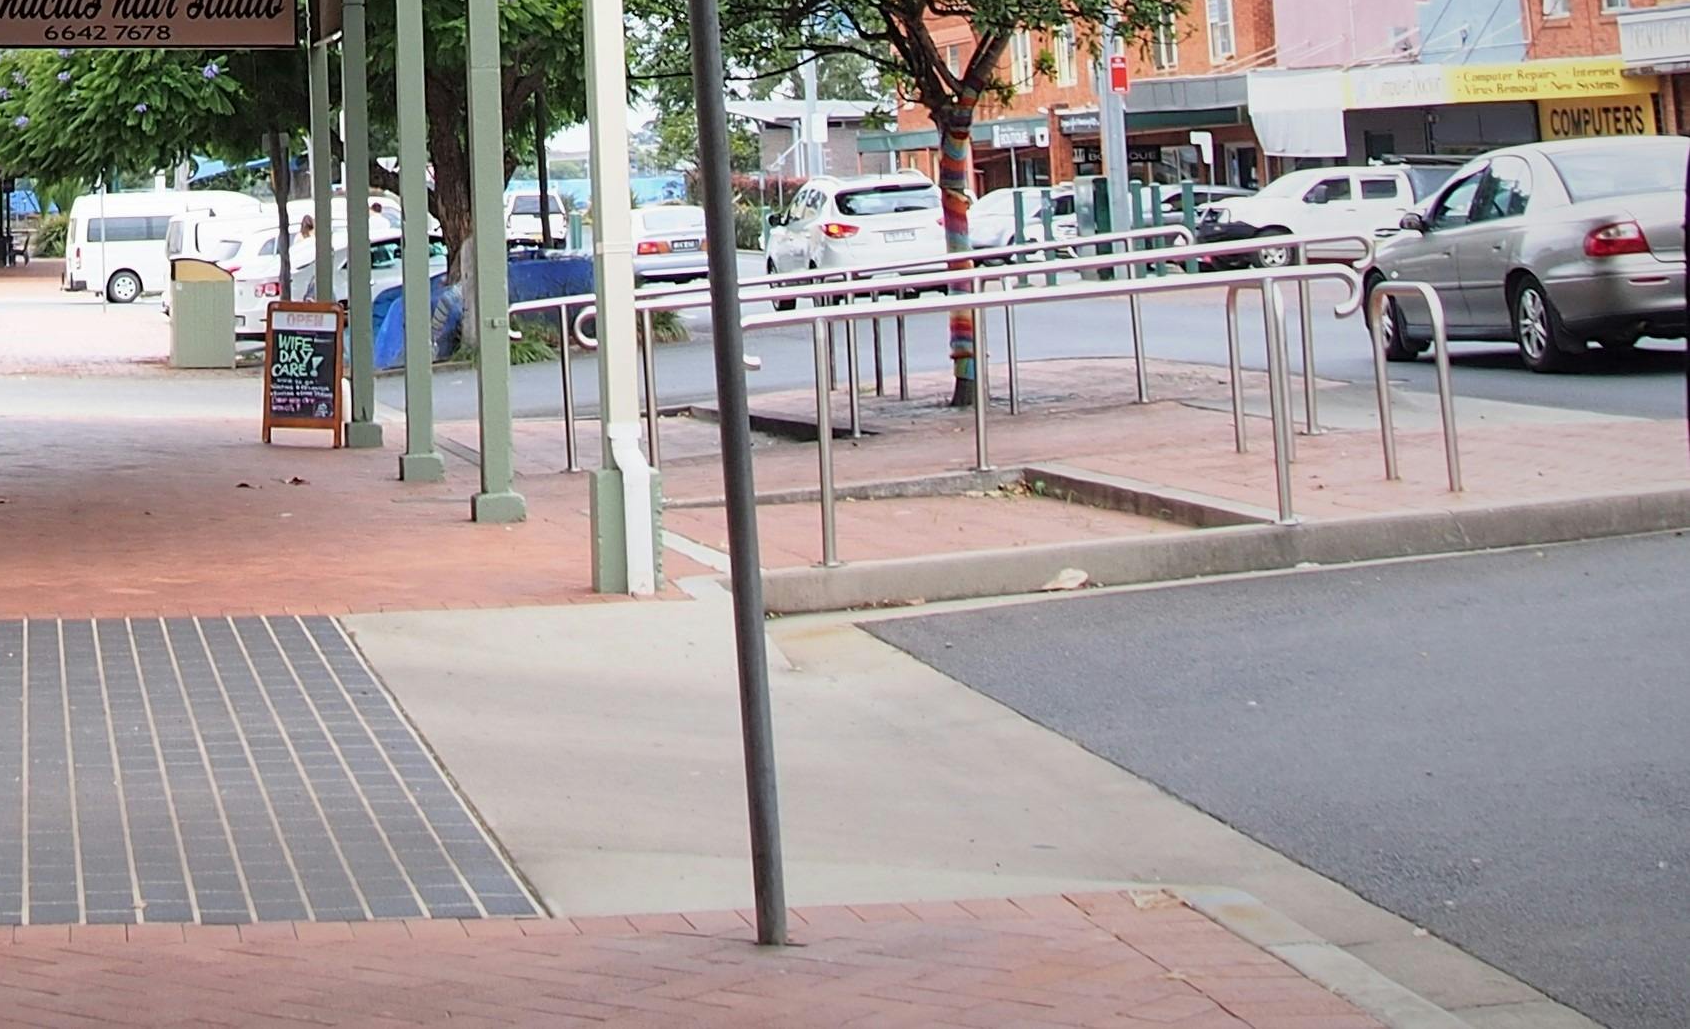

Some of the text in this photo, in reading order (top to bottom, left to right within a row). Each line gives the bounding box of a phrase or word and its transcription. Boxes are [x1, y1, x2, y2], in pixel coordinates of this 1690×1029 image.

[44, 25, 171, 41] 6642 7678
[1463, 66, 1616, 83] Computer Repairs Internet
[1464, 84, 1493, 95] Virus
[1496, 82, 1539, 94] Removal
[1576, 79, 1621, 92] Systems
[1550, 105, 1645, 137] COMPUTERS
[287, 313, 324, 327] OPEN
[277, 333, 314, 352] WIFE
[278, 349, 315, 365] DAY
